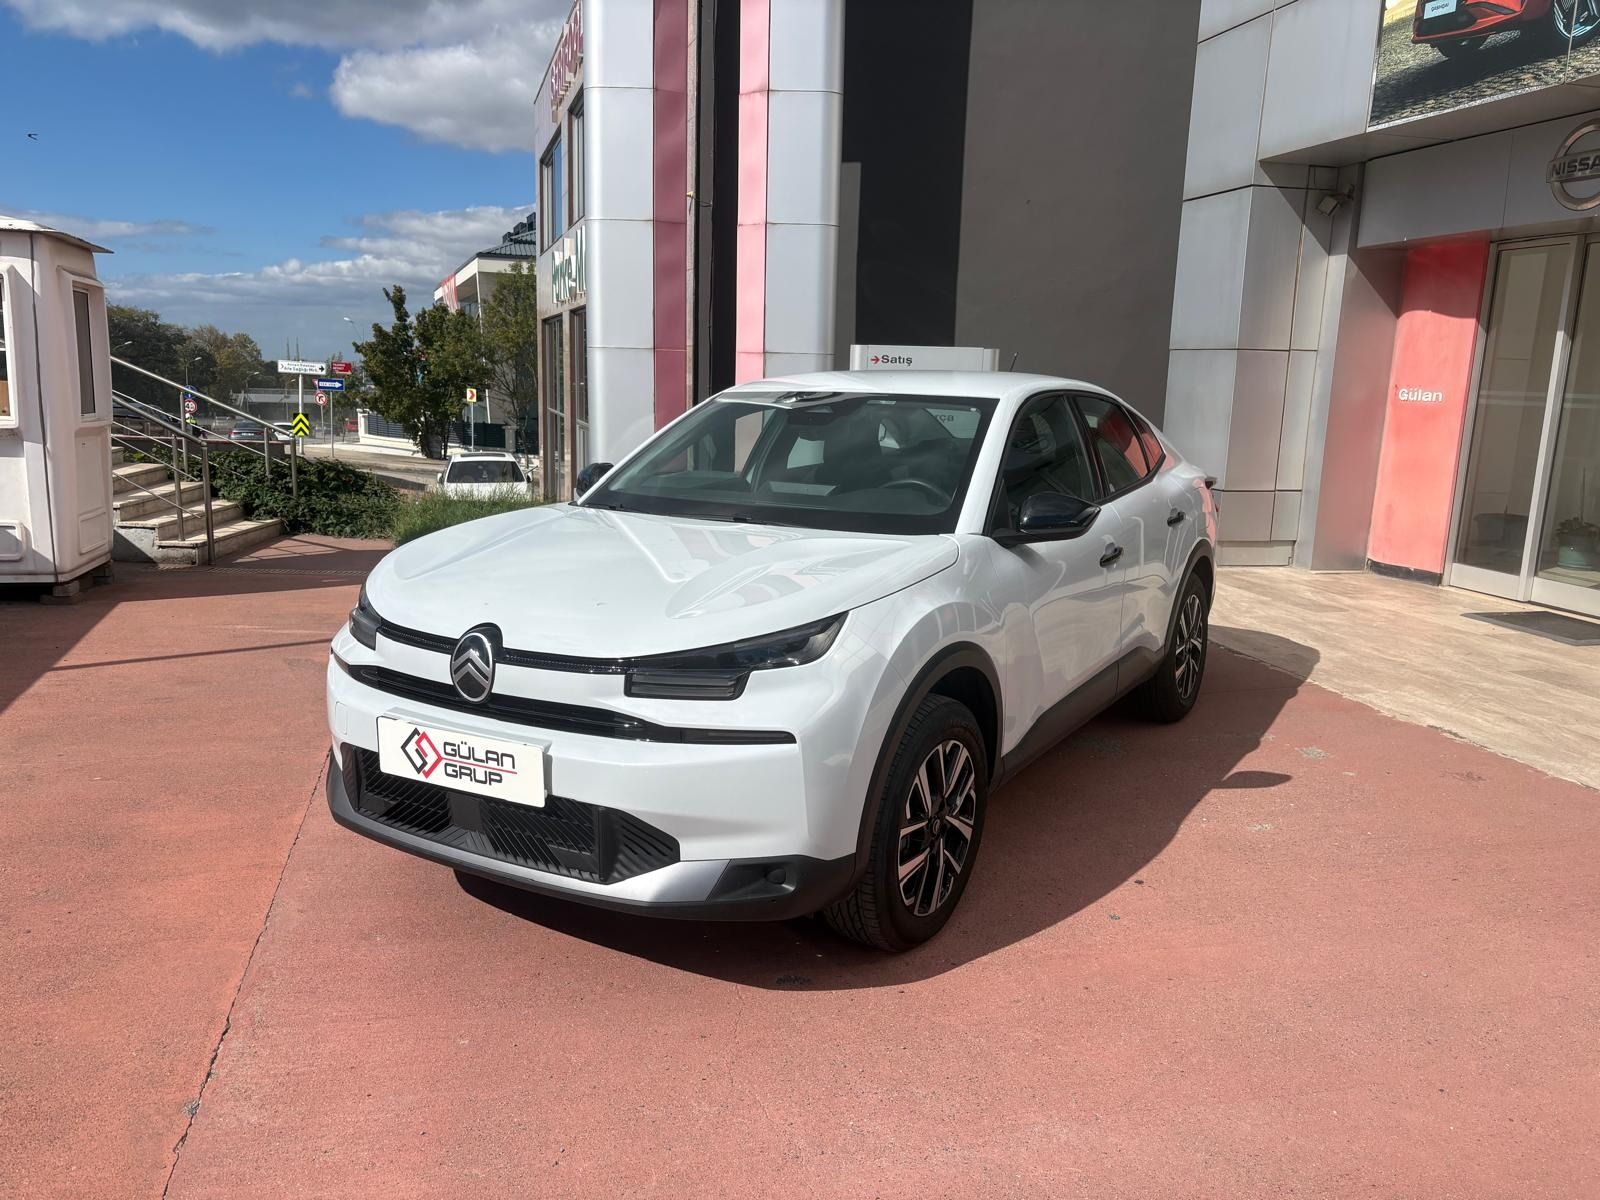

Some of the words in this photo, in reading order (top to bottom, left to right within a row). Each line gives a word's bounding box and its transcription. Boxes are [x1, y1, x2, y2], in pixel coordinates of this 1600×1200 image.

[881, 354, 913, 367] Satış
[1398, 388, 1442, 402] Gülan
[443, 741, 516, 769] GÜLAN
[444, 762, 504, 786] GRUP
